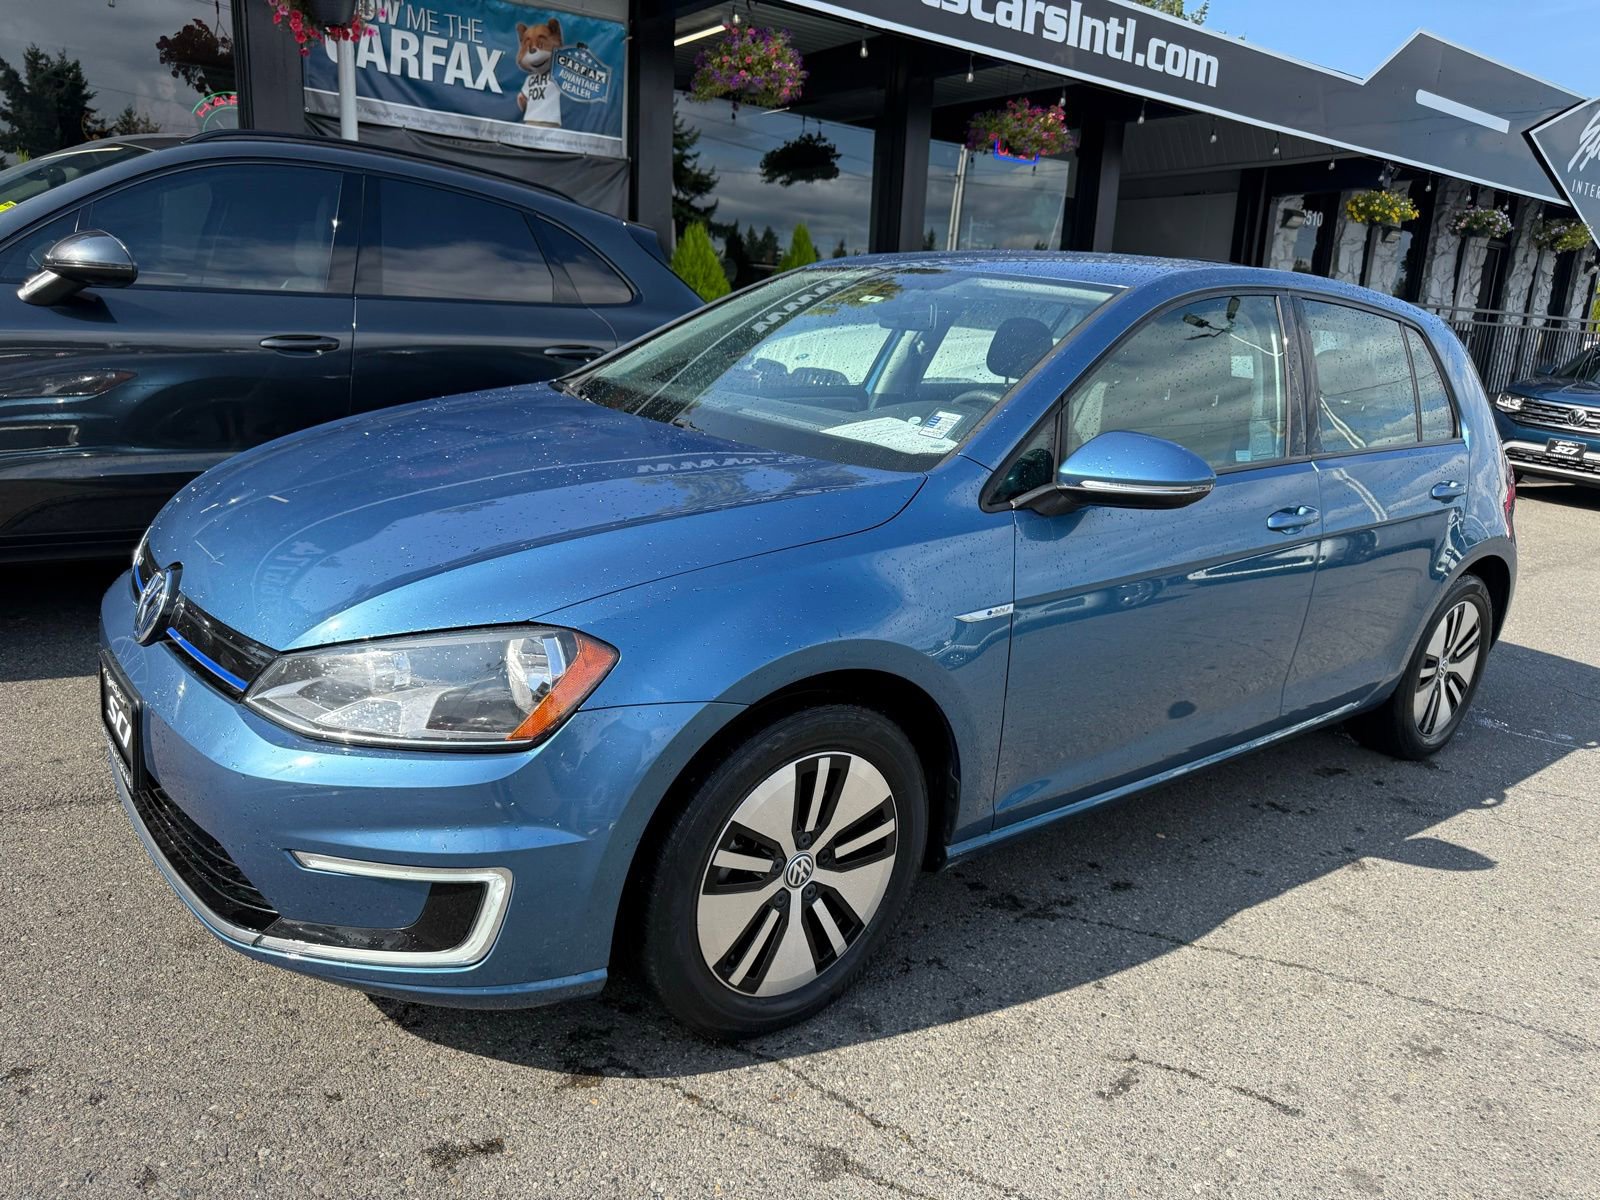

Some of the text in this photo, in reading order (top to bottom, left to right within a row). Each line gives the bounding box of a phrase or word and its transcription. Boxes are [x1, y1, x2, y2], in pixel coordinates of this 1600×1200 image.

[406, 4, 439, 35] ME
[444, 13, 484, 44] THE
[920, 0, 1219, 88] arsIntl.com
[528, 73, 549, 87] CAR
[558, 57, 606, 84] CARFAX
[559, 69, 600, 92] ADVANTAGE
[528, 87, 546, 101] FOX
[562, 81, 591, 99] DEALER
